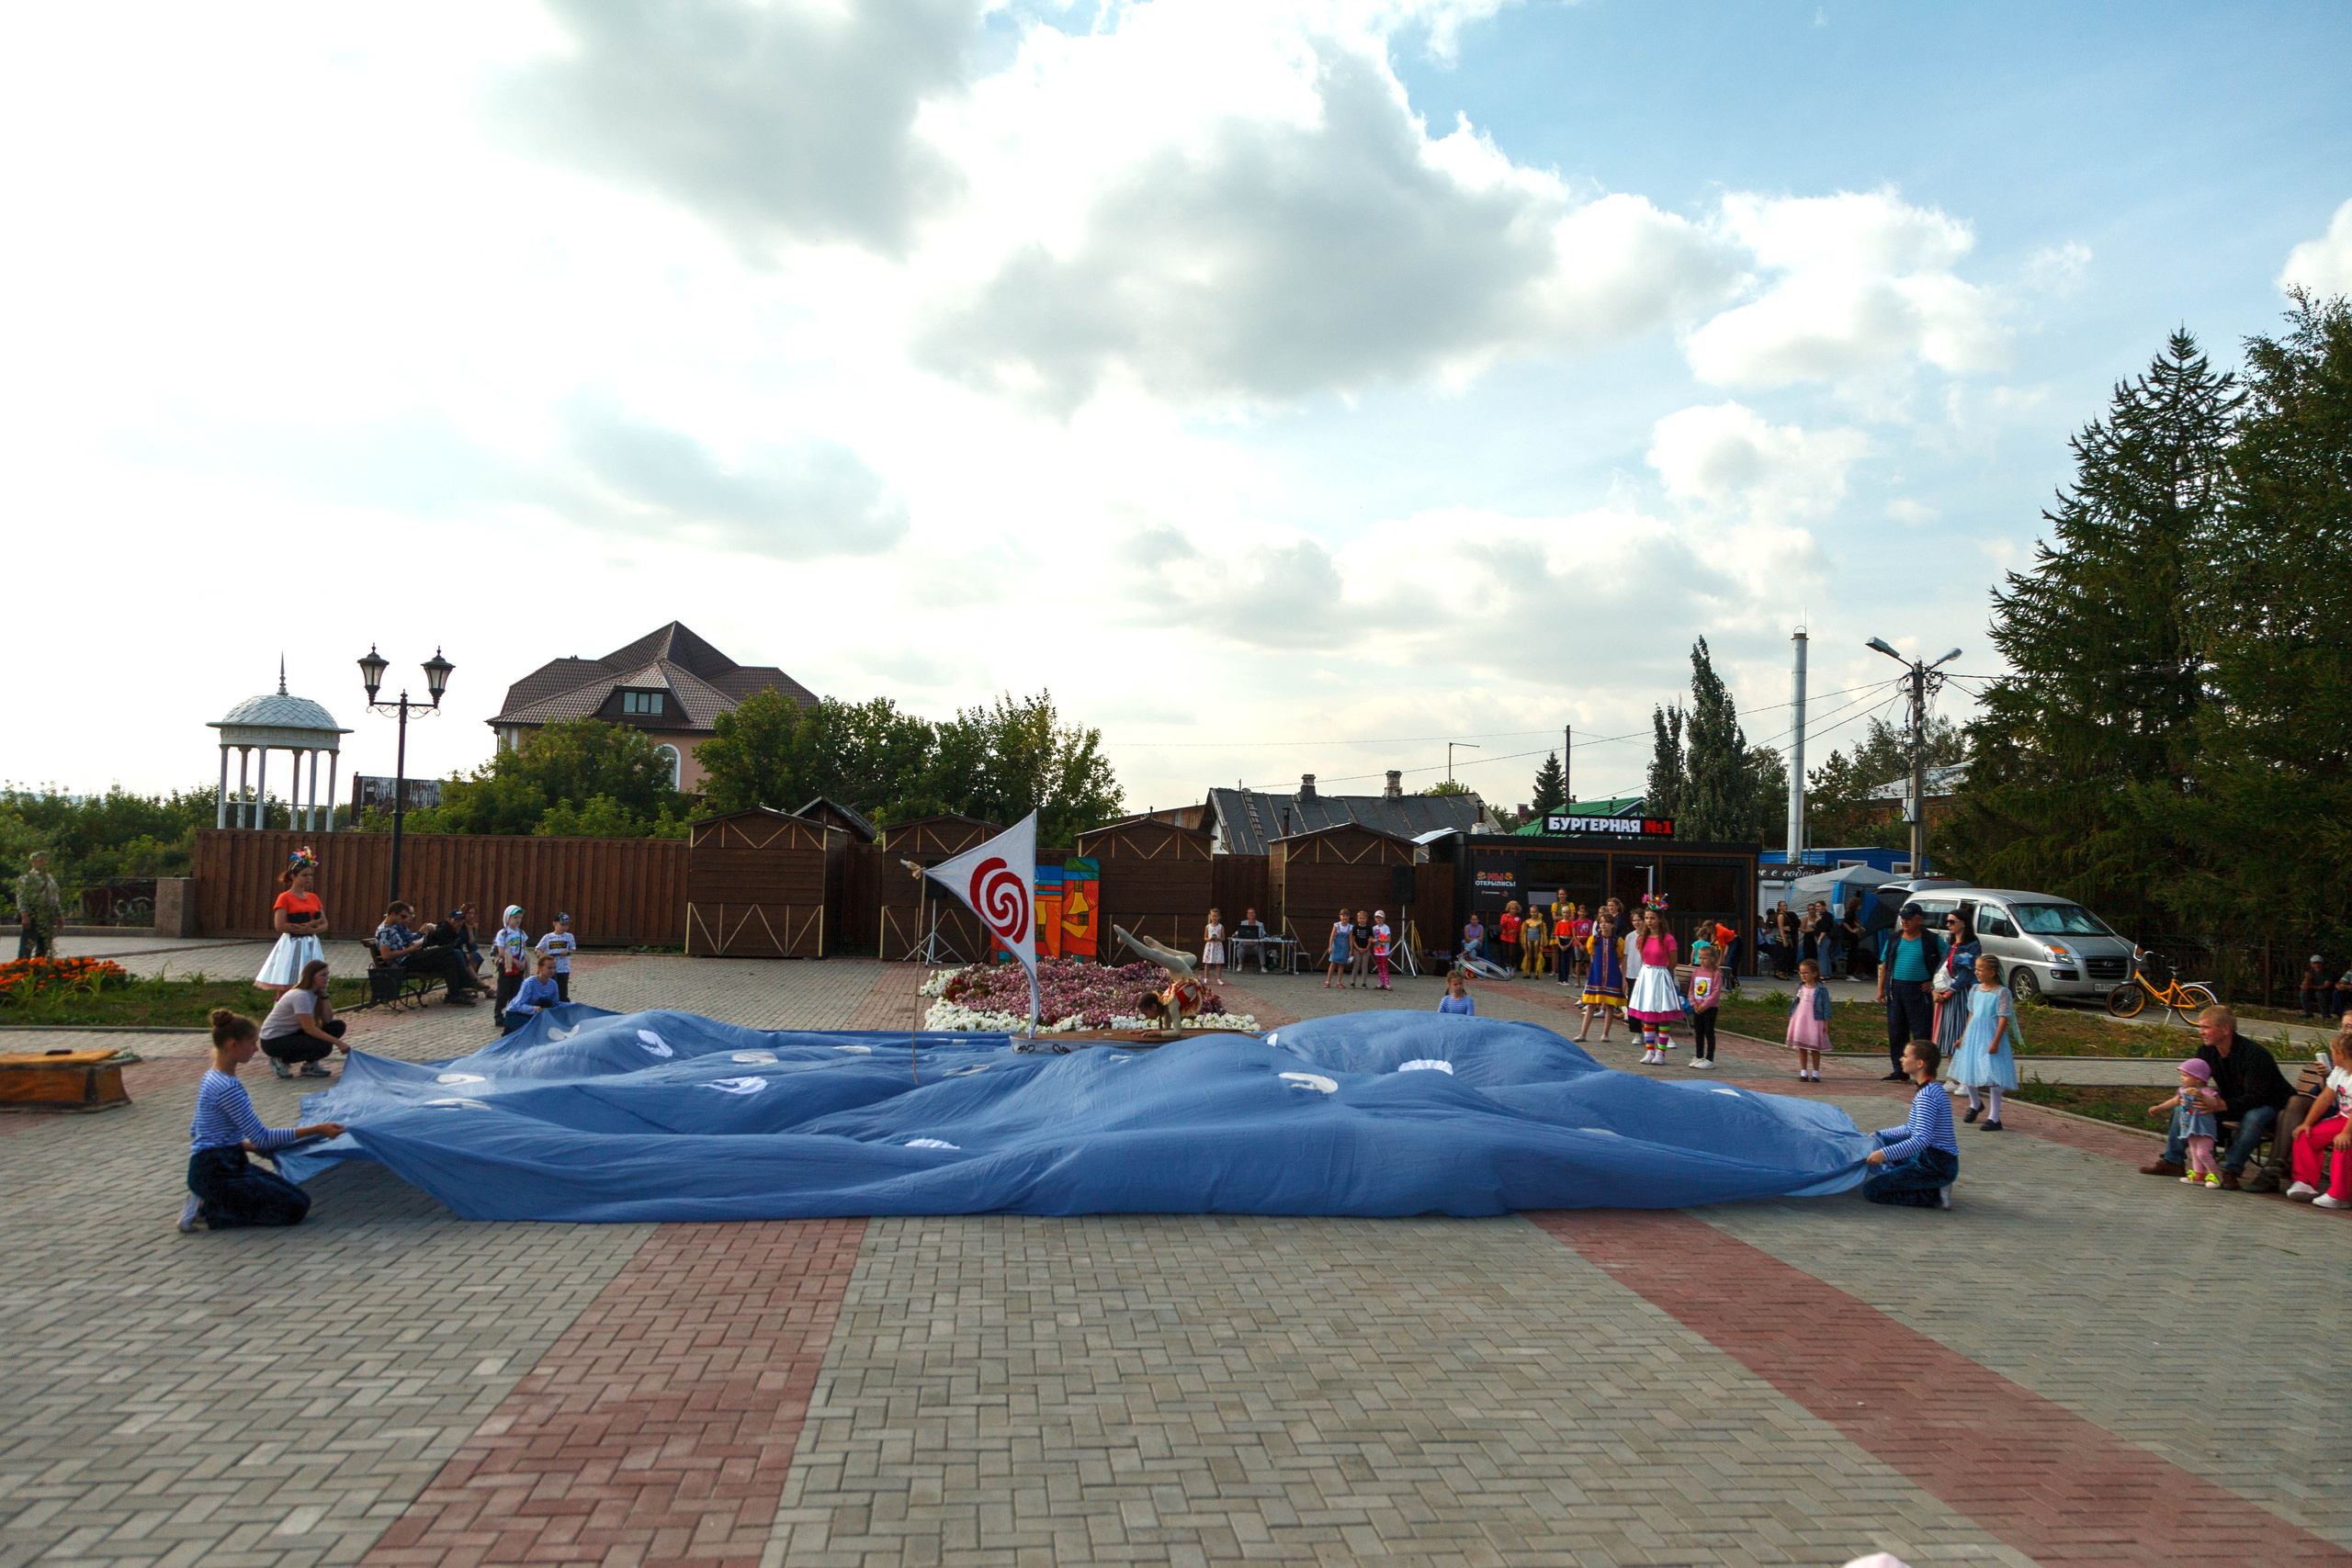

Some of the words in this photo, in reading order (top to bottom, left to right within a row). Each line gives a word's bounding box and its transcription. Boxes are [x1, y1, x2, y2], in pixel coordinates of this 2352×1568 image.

[1548, 817, 1641, 833] БУРГЕРНАЯ
[1645, 819, 1672, 834] №1
[1782, 865, 1816, 877] собой
